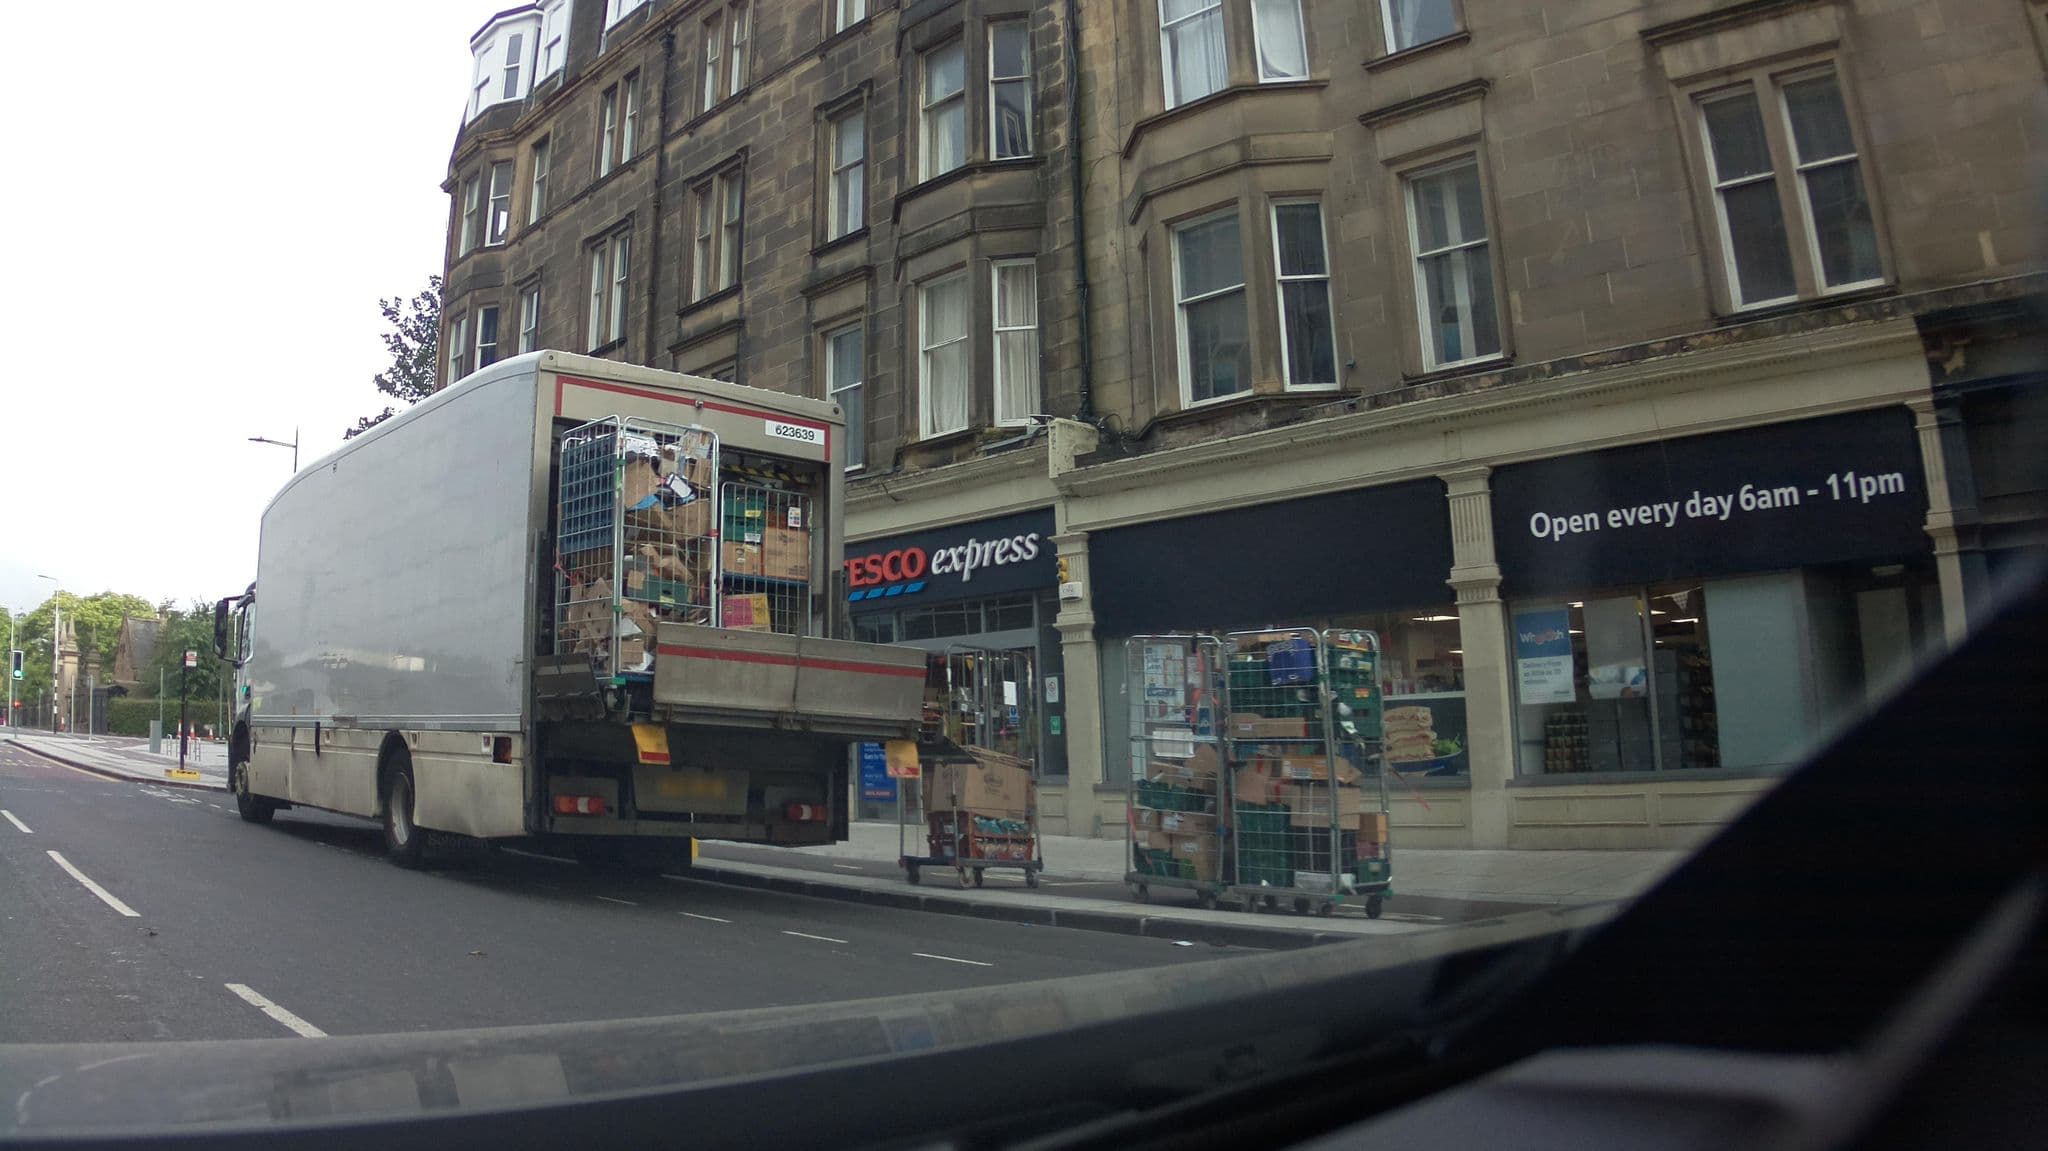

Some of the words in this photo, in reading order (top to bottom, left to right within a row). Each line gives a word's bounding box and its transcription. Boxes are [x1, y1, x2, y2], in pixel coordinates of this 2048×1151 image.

[775, 425, 815, 441] 623639
[1530, 512, 1600, 541] Open
[1607, 501, 1680, 528] every
[1685, 490, 1734, 521] day
[1739, 484, 1800, 511] 6am
[1826, 471, 1905, 504] 11pm
[844, 547, 928, 587] ESCO
[931, 532, 1040, 583] express
